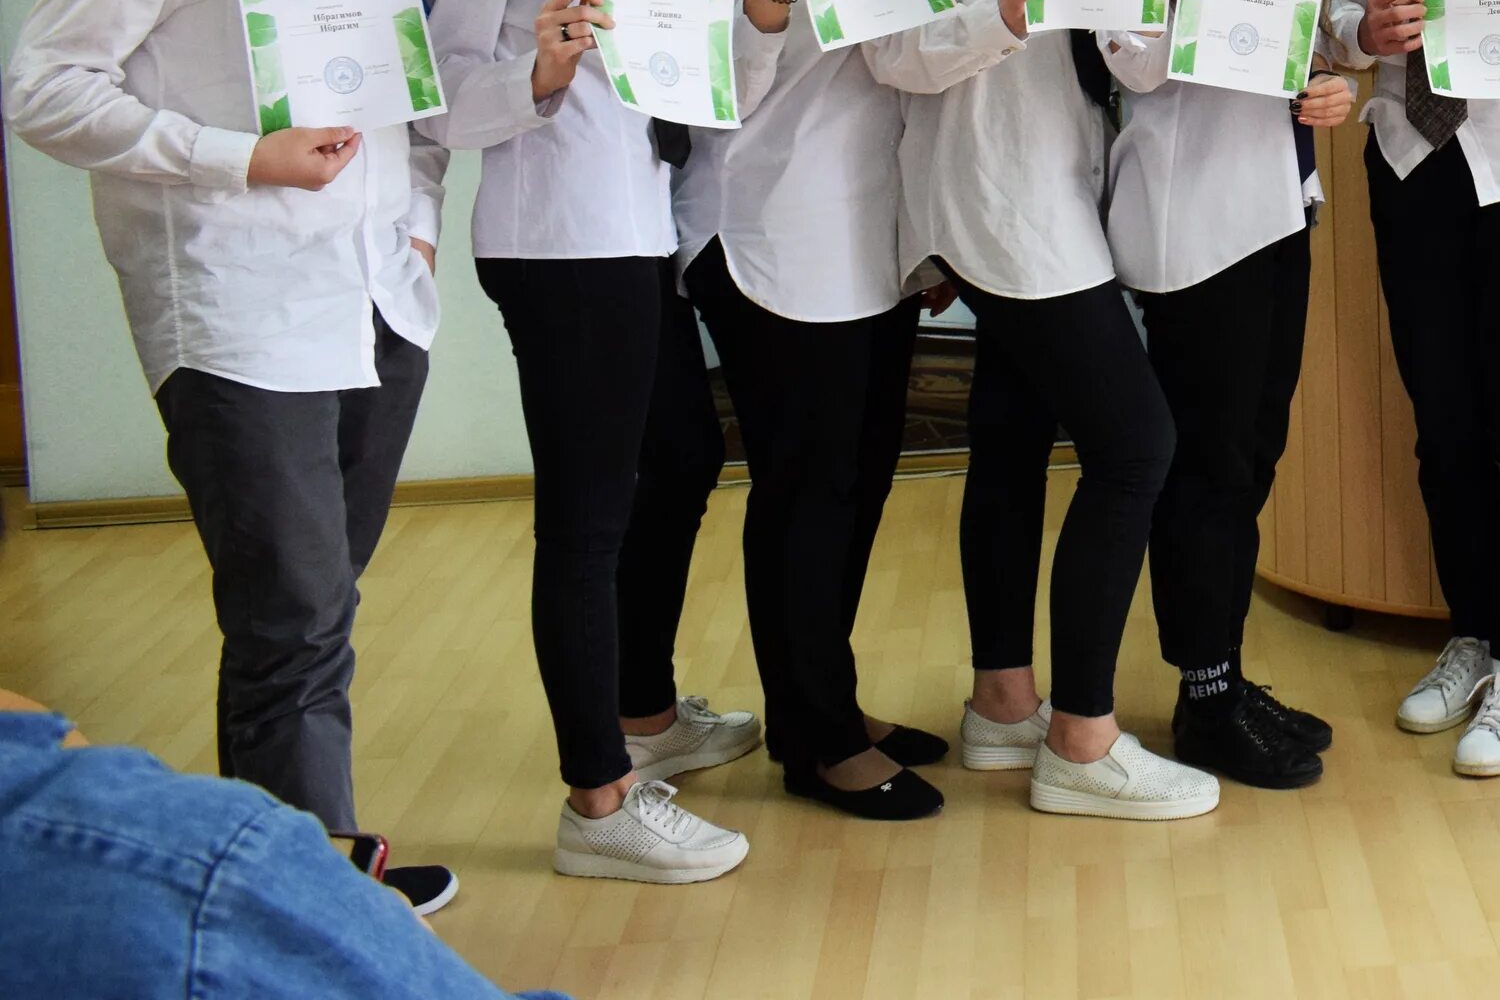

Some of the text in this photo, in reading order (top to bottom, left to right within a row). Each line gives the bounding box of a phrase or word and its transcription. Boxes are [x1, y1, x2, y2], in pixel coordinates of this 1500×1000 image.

[313, 10, 362, 22] Ибрагимов
[320, 21, 359, 33] Ибрагим
[1189, 679, 1228, 700] ДЕНЬ
